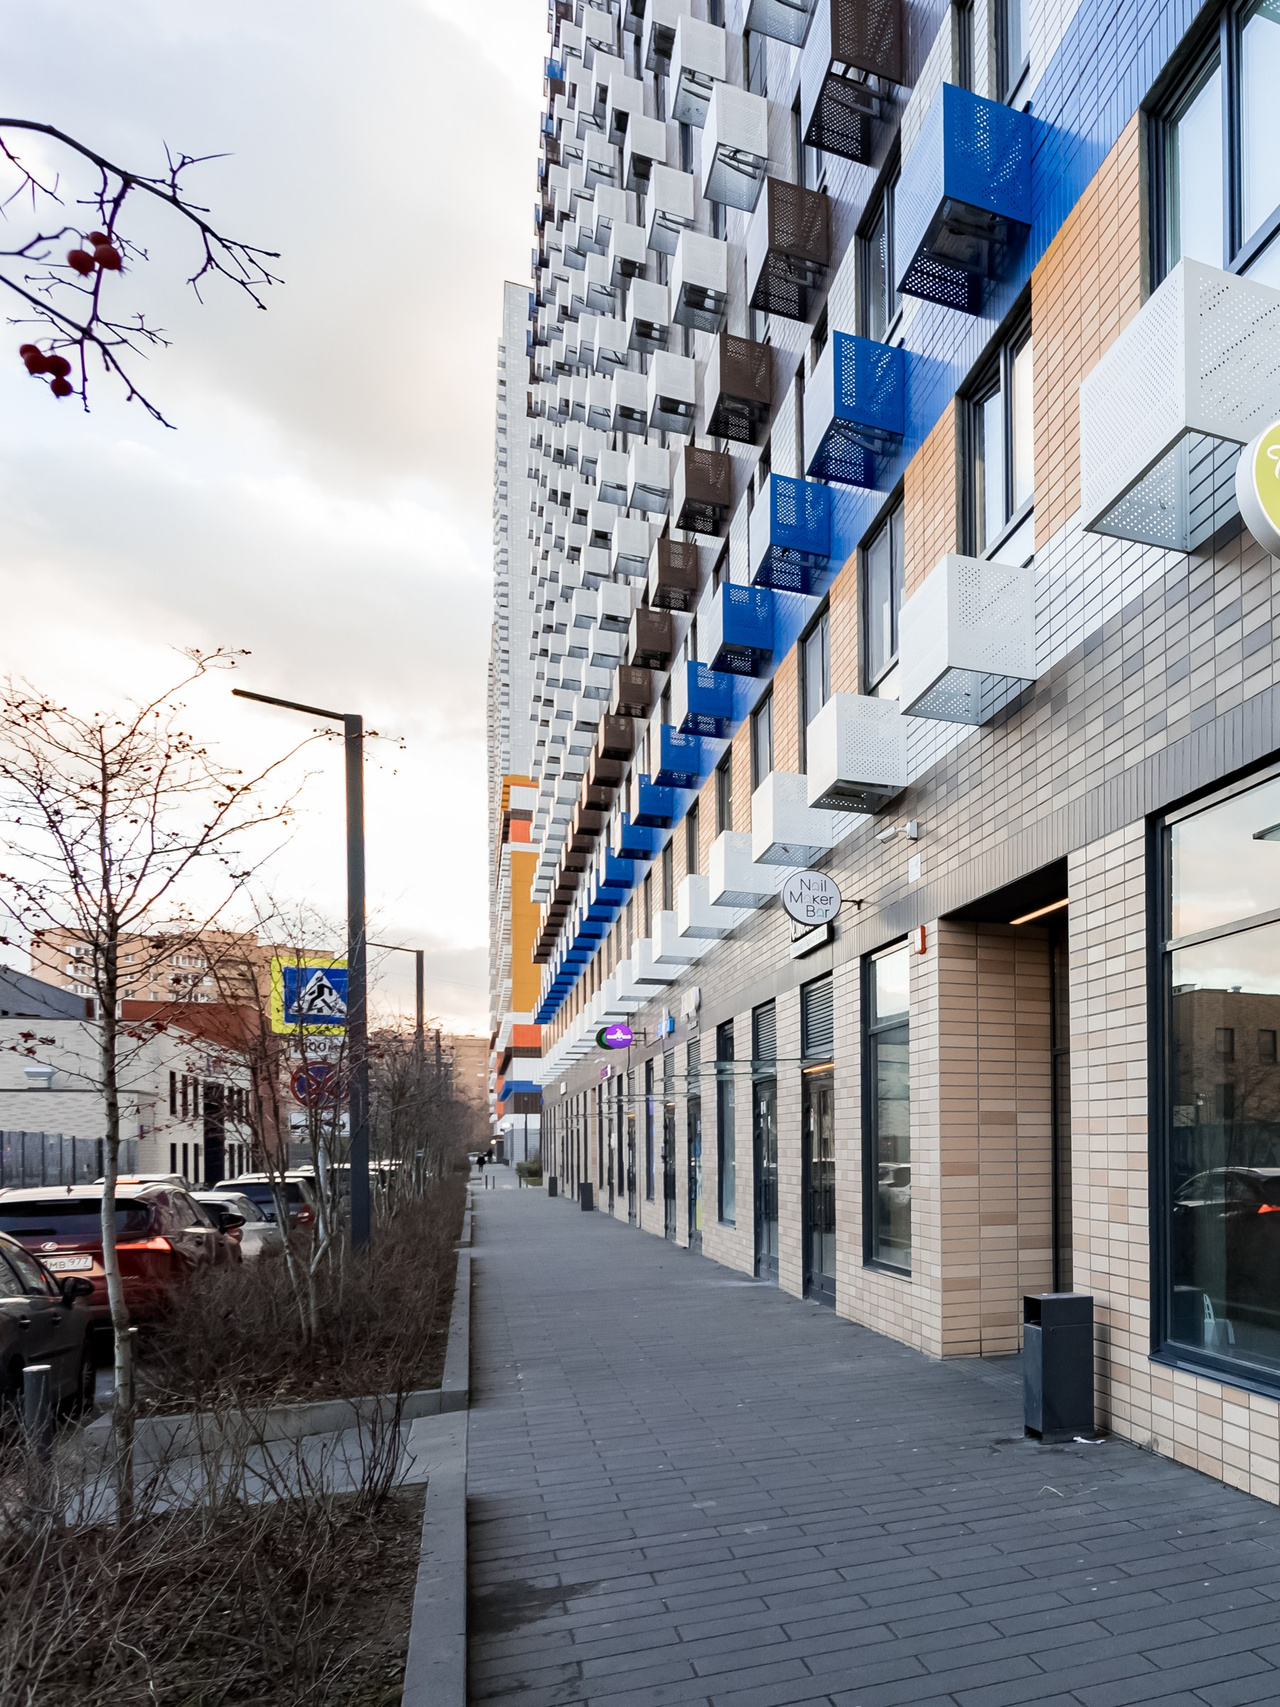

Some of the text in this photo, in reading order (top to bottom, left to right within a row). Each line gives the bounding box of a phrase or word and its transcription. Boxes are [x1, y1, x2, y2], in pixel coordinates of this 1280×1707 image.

[800, 878, 827, 892] Nail
[789, 890, 834, 905] Maker
[806, 904, 830, 918] Bar
